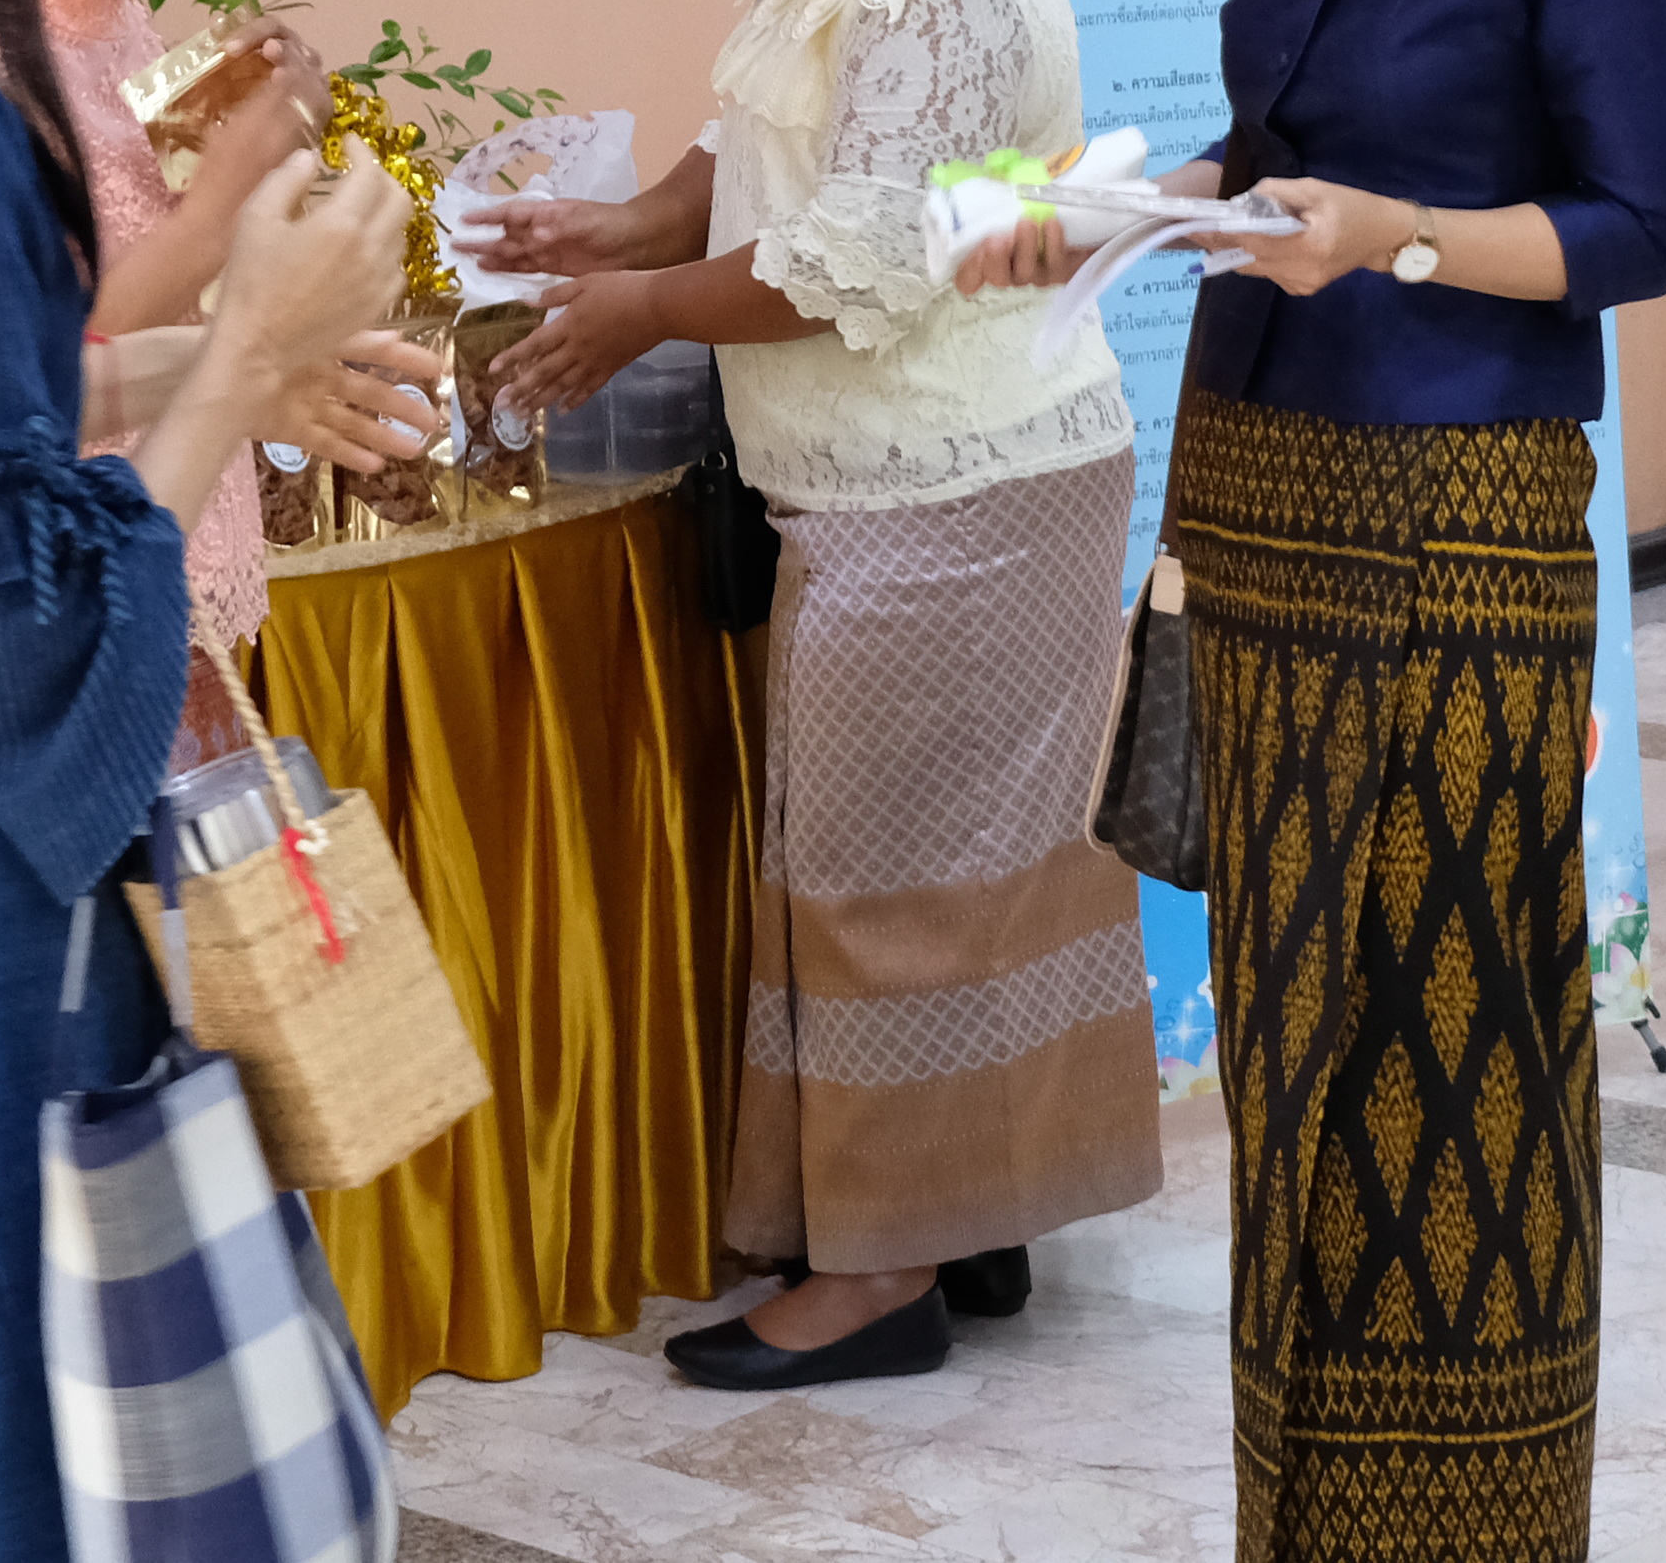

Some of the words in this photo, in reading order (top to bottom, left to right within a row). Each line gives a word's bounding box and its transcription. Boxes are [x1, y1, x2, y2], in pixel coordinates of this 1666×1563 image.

[1132, 69, 1212, 91] ความเสียสละ
